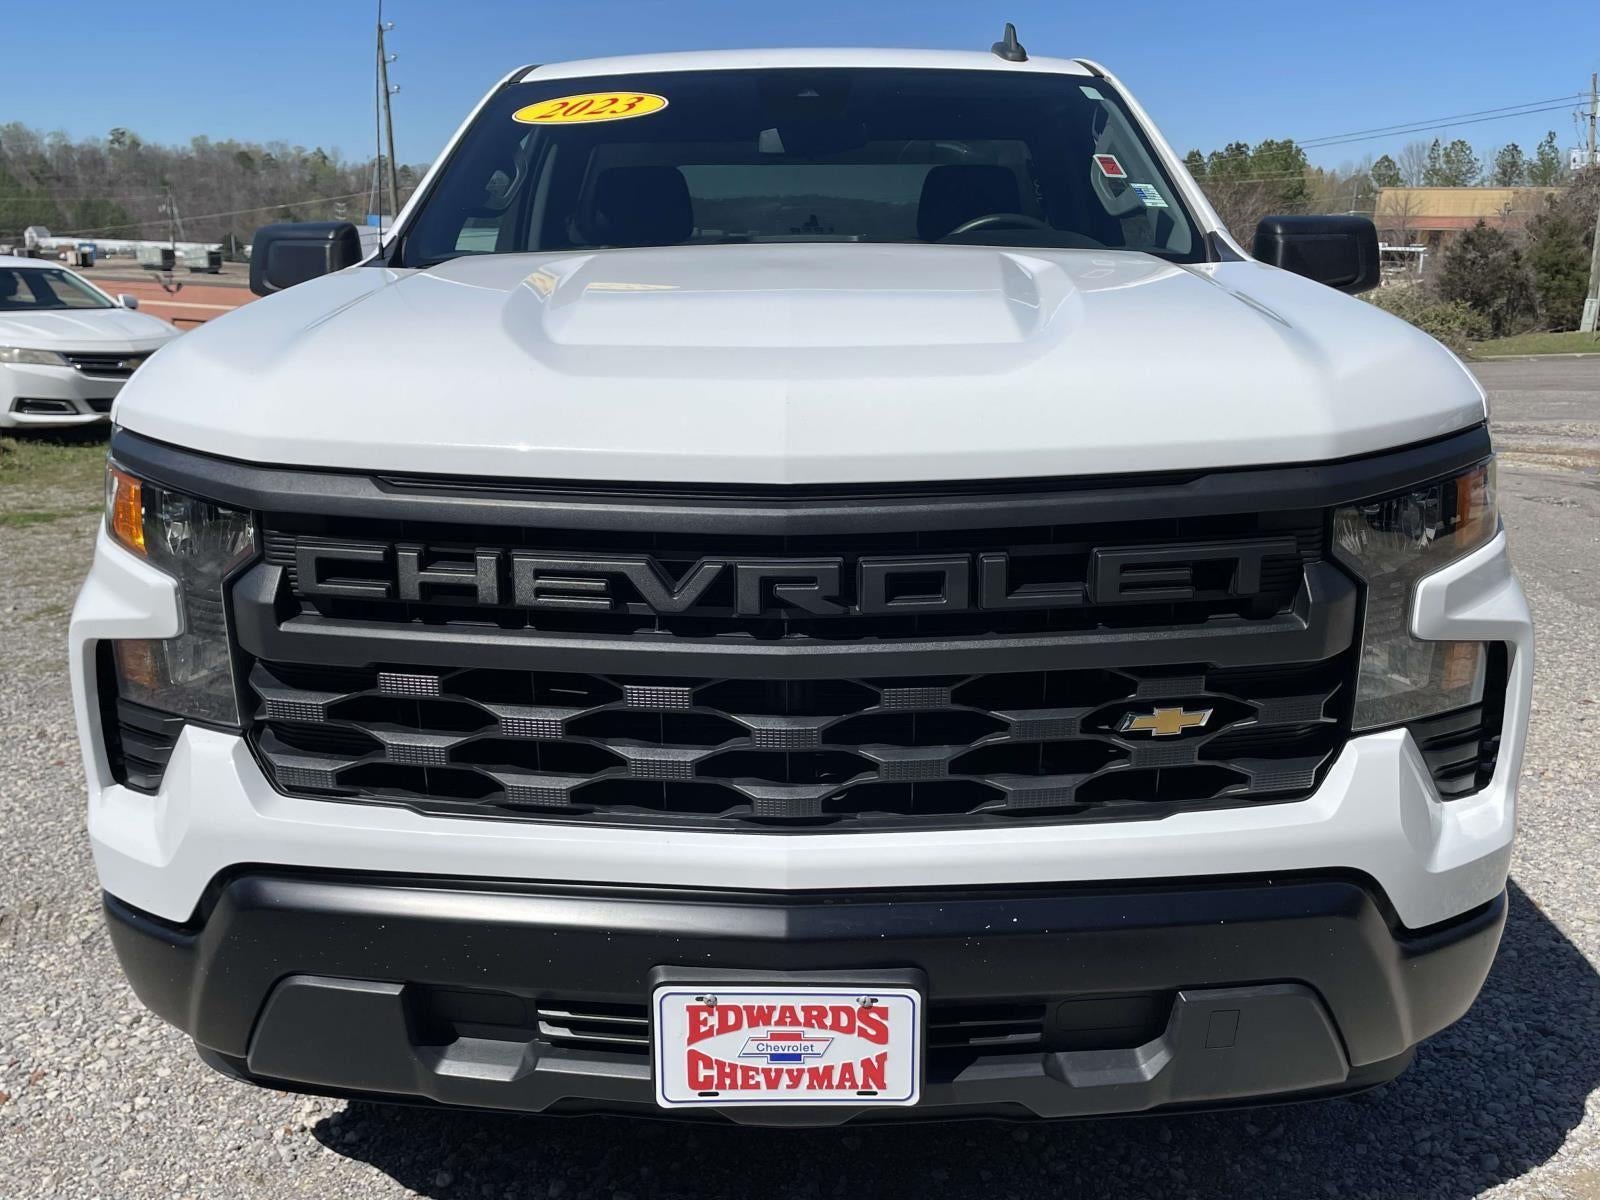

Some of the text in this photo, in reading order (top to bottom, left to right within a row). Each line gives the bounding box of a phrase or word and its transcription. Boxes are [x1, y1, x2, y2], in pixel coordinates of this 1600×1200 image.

[534, 96, 645, 119] 2023
[296, 536, 1297, 618] CHEVROLET
[686, 1004, 889, 1046] EDWARDS
[756, 1042, 815, 1053] Chevrolet
[686, 1048, 888, 1091] CHEVYMAN
